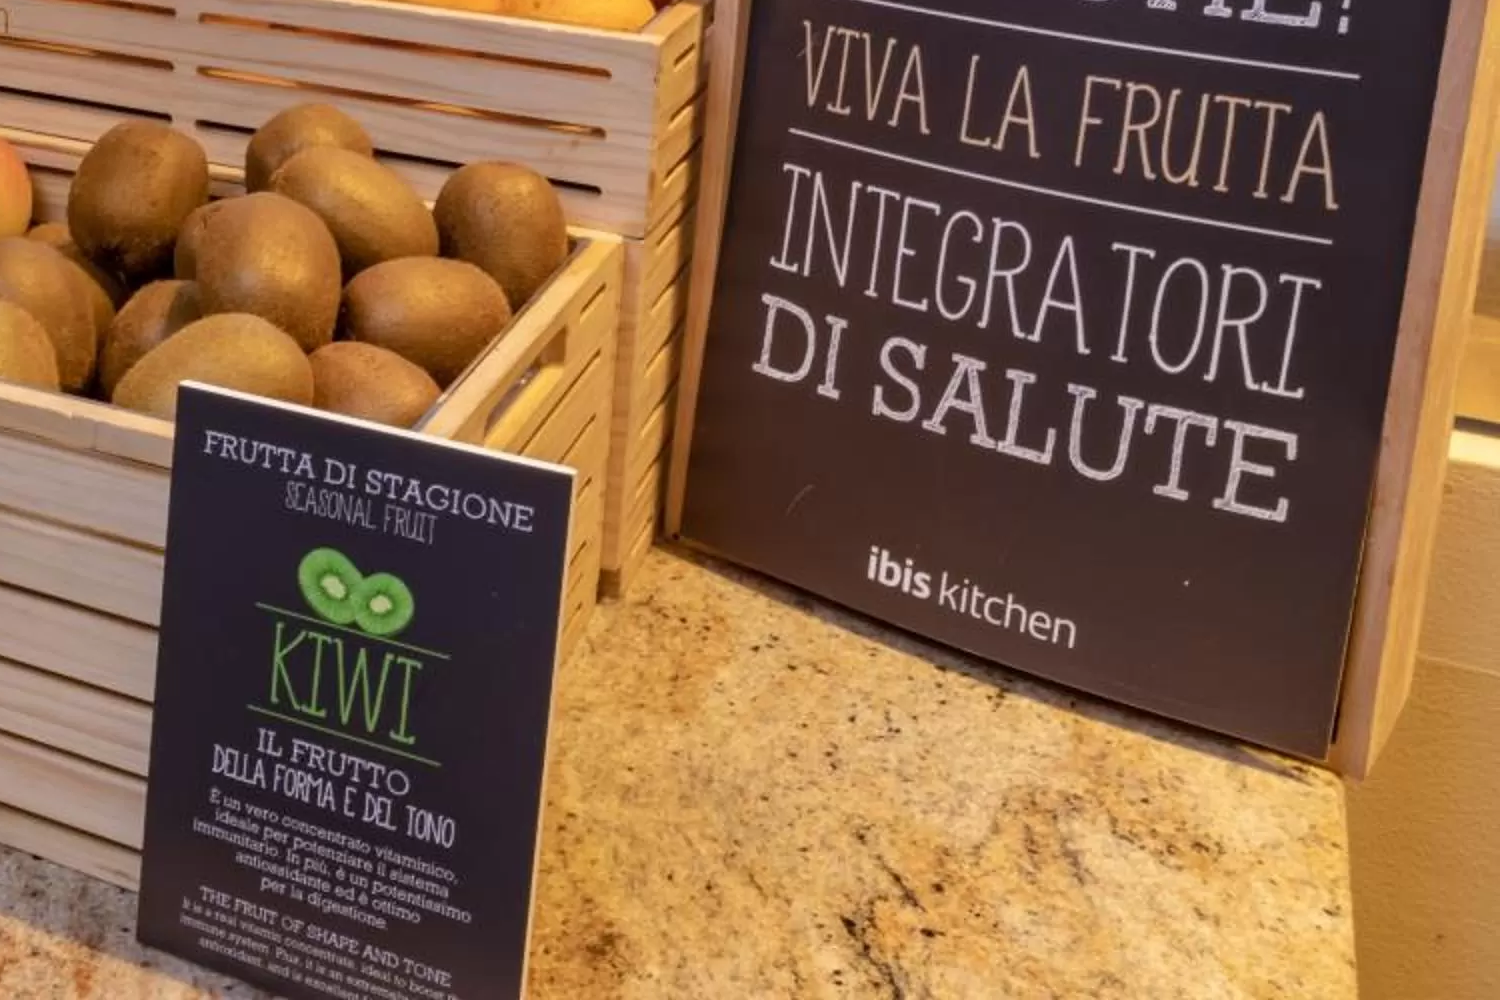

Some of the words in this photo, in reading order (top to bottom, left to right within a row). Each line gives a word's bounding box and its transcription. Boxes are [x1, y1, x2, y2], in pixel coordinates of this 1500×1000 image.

[802, 19, 930, 136] VIVA
[959, 53, 1041, 159] LA
[1073, 74, 1339, 211] FRUTTA
[769, 163, 1321, 399] INTEGRATORI
[753, 293, 848, 399] DI
[871, 335, 1299, 523] SALUTE
[203, 429, 316, 479] FRUTTA
[323, 457, 357, 488] DI
[364, 470, 534, 533] STAGIONE
[284, 480, 377, 530] SEASONAL
[382, 505, 438, 545] FRUIT
[867, 545, 931, 600] ibis
[939, 575, 1077, 649] kitchen
[270, 621, 423, 744] KIWI
[211, 743, 266, 789] DELLA
[272, 763, 336, 812] FORMA
[343, 789, 357, 818] E
[362, 796, 397, 831] DEL
[405, 804, 456, 849] TONO
[256, 728, 283, 758] IL
[290, 739, 411, 796] FRUTTO
[199, 885, 232, 909] THE
[361, 944, 399, 969] AND
[403, 956, 452, 988] TONE
